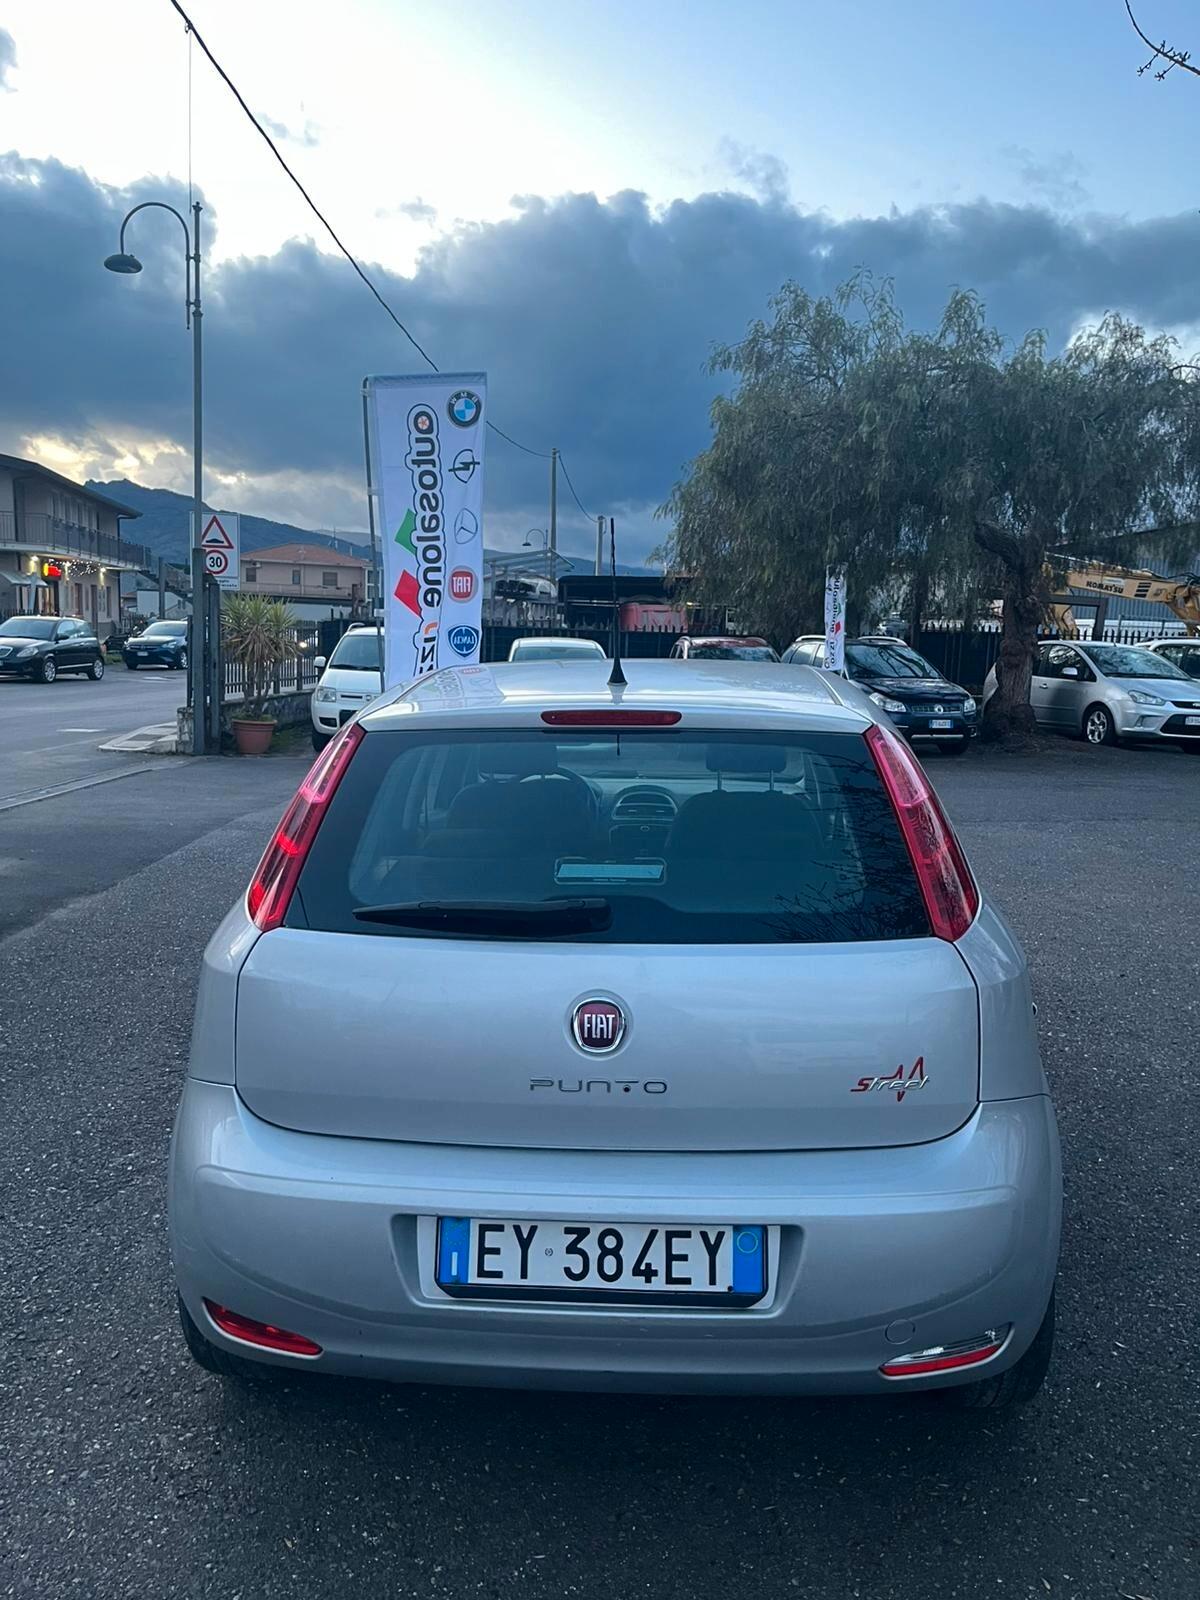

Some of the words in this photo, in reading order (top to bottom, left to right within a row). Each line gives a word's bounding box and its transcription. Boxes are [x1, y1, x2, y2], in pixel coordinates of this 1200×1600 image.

[209, 556, 222, 568] 30
[1086, 580, 1124, 594] KOMATSU
[583, 1013, 615, 1039] FIAT
[529, 1078, 668, 1095] PUNTO
[475, 1223, 539, 1281] EY
[562, 1226, 727, 1287] 384EY
